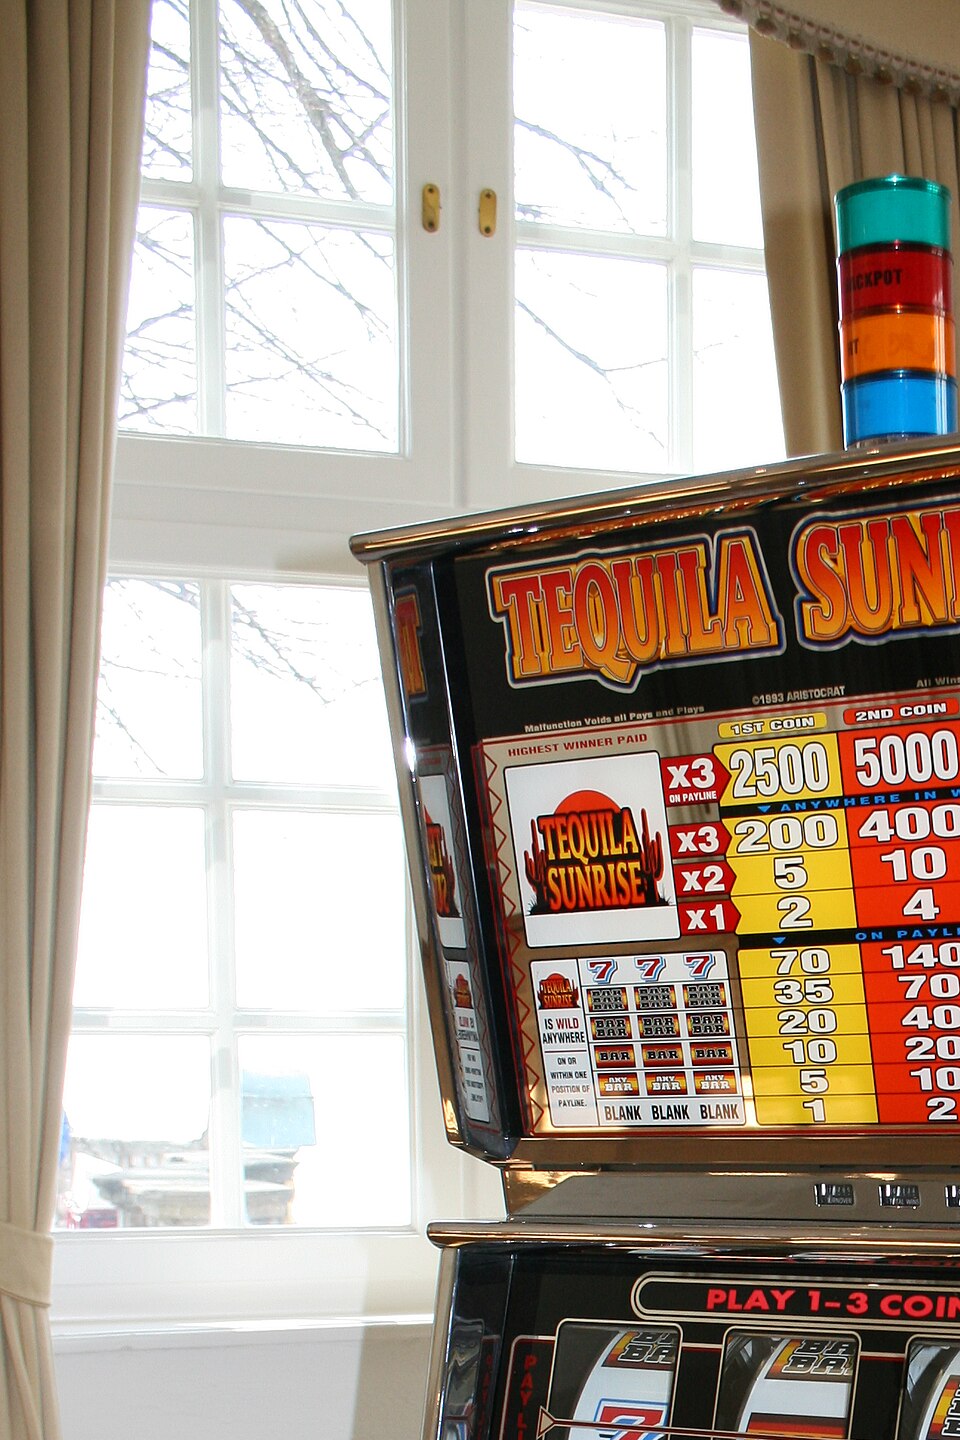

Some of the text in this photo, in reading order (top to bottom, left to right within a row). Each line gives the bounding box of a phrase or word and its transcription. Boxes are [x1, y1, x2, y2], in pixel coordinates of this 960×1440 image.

[497, 536, 780, 682] TEQUILA
[786, 685, 846, 702] ARISTOCRAT
[916, 679, 931, 688] All
[524, 705, 705, 733] Malfunction Voids all Pays and Plays
[855, 702, 947, 722] 2ND COIN
[730, 715, 815, 736] 1ST COIN
[507, 733, 649, 758] HIGHEST WINNER PAID
[729, 741, 830, 799] 2500
[853, 729, 960, 788] 5000
[669, 790, 718, 804] ON PAYLINE
[780, 793, 900, 813] ANYWHERE
[914, 786, 937, 801] IN
[539, 807, 640, 862] TEQUILA
[733, 814, 840, 855] 200
[773, 856, 809, 891] 5
[881, 846, 948, 882] 10
[547, 859, 647, 911] SUNRISE
[777, 895, 813, 931] 2
[902, 888, 940, 922] 4
[854, 930, 885, 942] ON
[587, 952, 717, 985] 7 7 7
[770, 946, 831, 976] 70
[773, 978, 835, 1005] 35
[544, 1017, 579, 1030] IS WILD
[596, 1015, 723, 1028] BAR BAR BAR
[596, 1024, 725, 1037] BAR BAR BAR
[777, 1008, 838, 1035] 20
[543, 1031, 585, 1044] ANYWHERE
[557, 1057, 577, 1065] ON OR
[600, 1048, 728, 1061] BAR BAR BAR
[782, 1037, 837, 1064] 10
[550, 1070, 587, 1079] WITHIN ONE
[798, 1069, 830, 1094] 5
[551, 1085, 580, 1094] POSITION
[558, 1099, 587, 1107] PAYLINE.
[604, 1103, 739, 1121] BLANK BLANK BLANK
[802, 1098, 826, 1124] 1
[926, 1096, 959, 1122] 2
[706, 1288, 796, 1311] PLAY
[807, 1290, 869, 1315] 1-3
